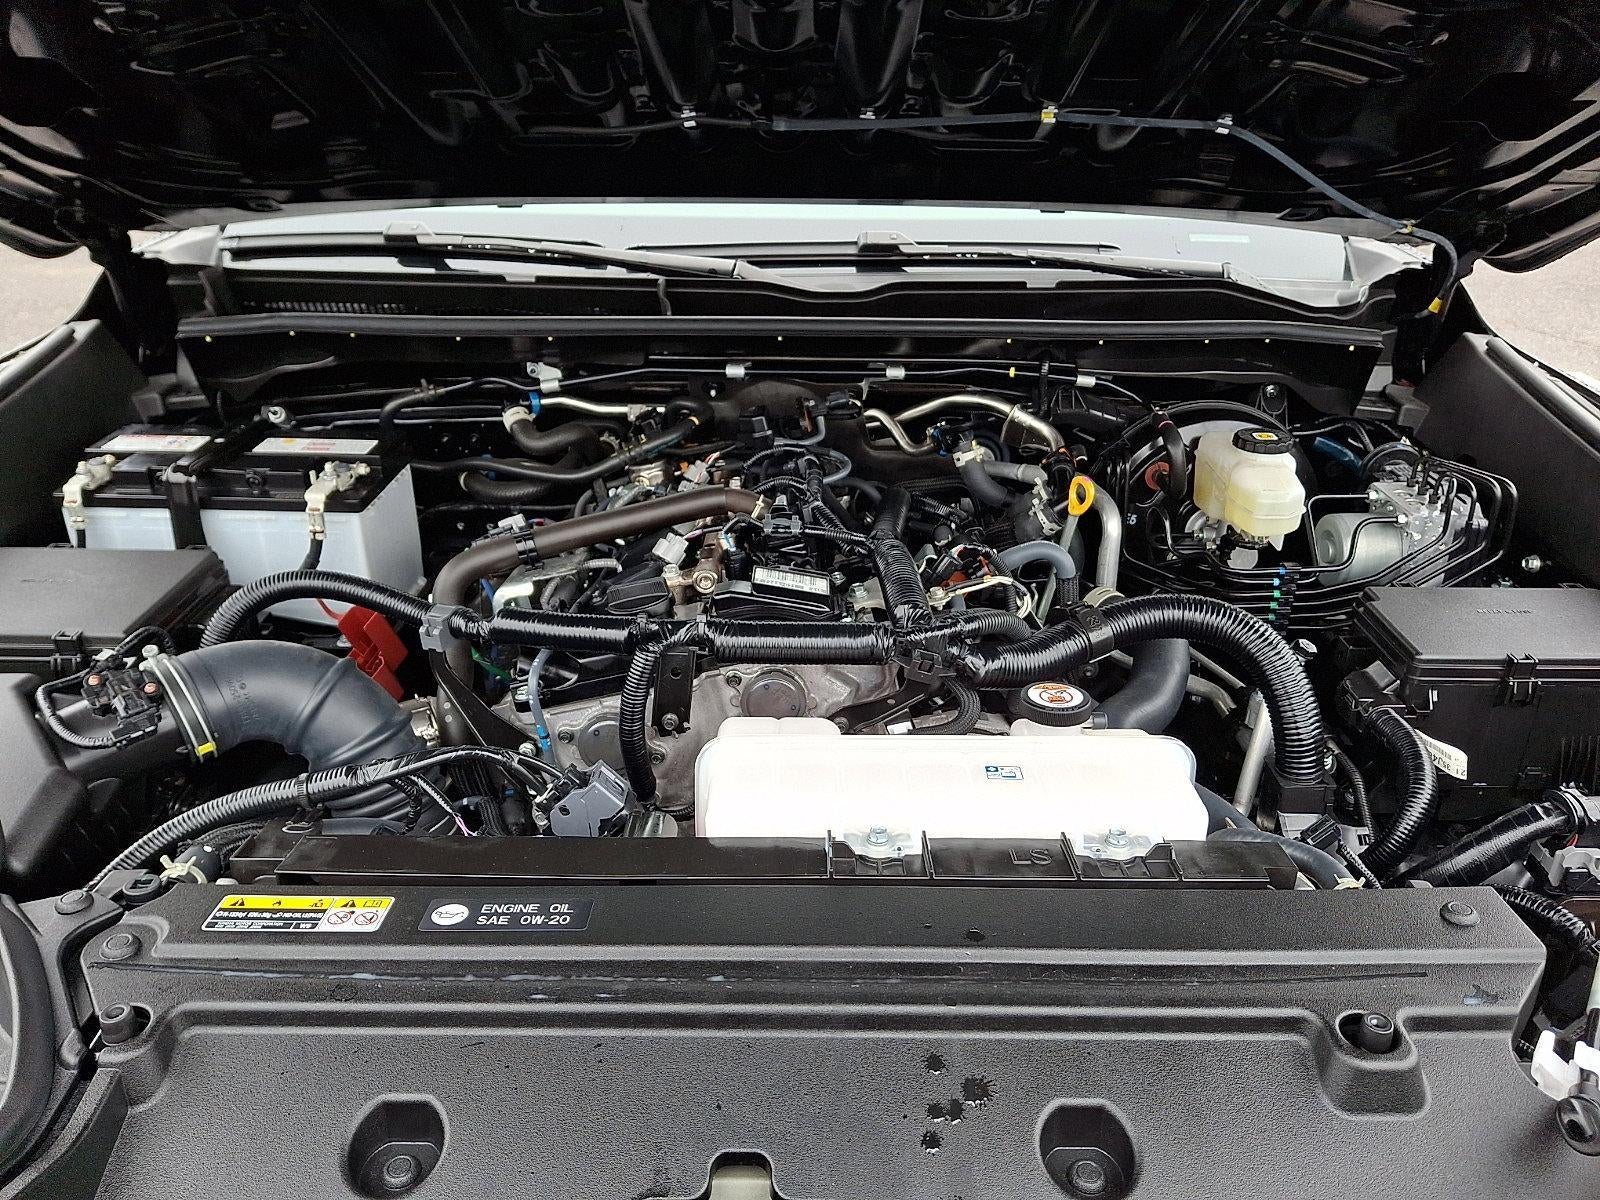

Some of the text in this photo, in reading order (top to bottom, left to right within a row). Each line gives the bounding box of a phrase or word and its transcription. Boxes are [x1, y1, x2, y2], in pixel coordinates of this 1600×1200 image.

[1008, 848, 1052, 865] LS
[480, 903, 574, 914] ENGINE OIL
[476, 915, 571, 925] SAE 0W-20
